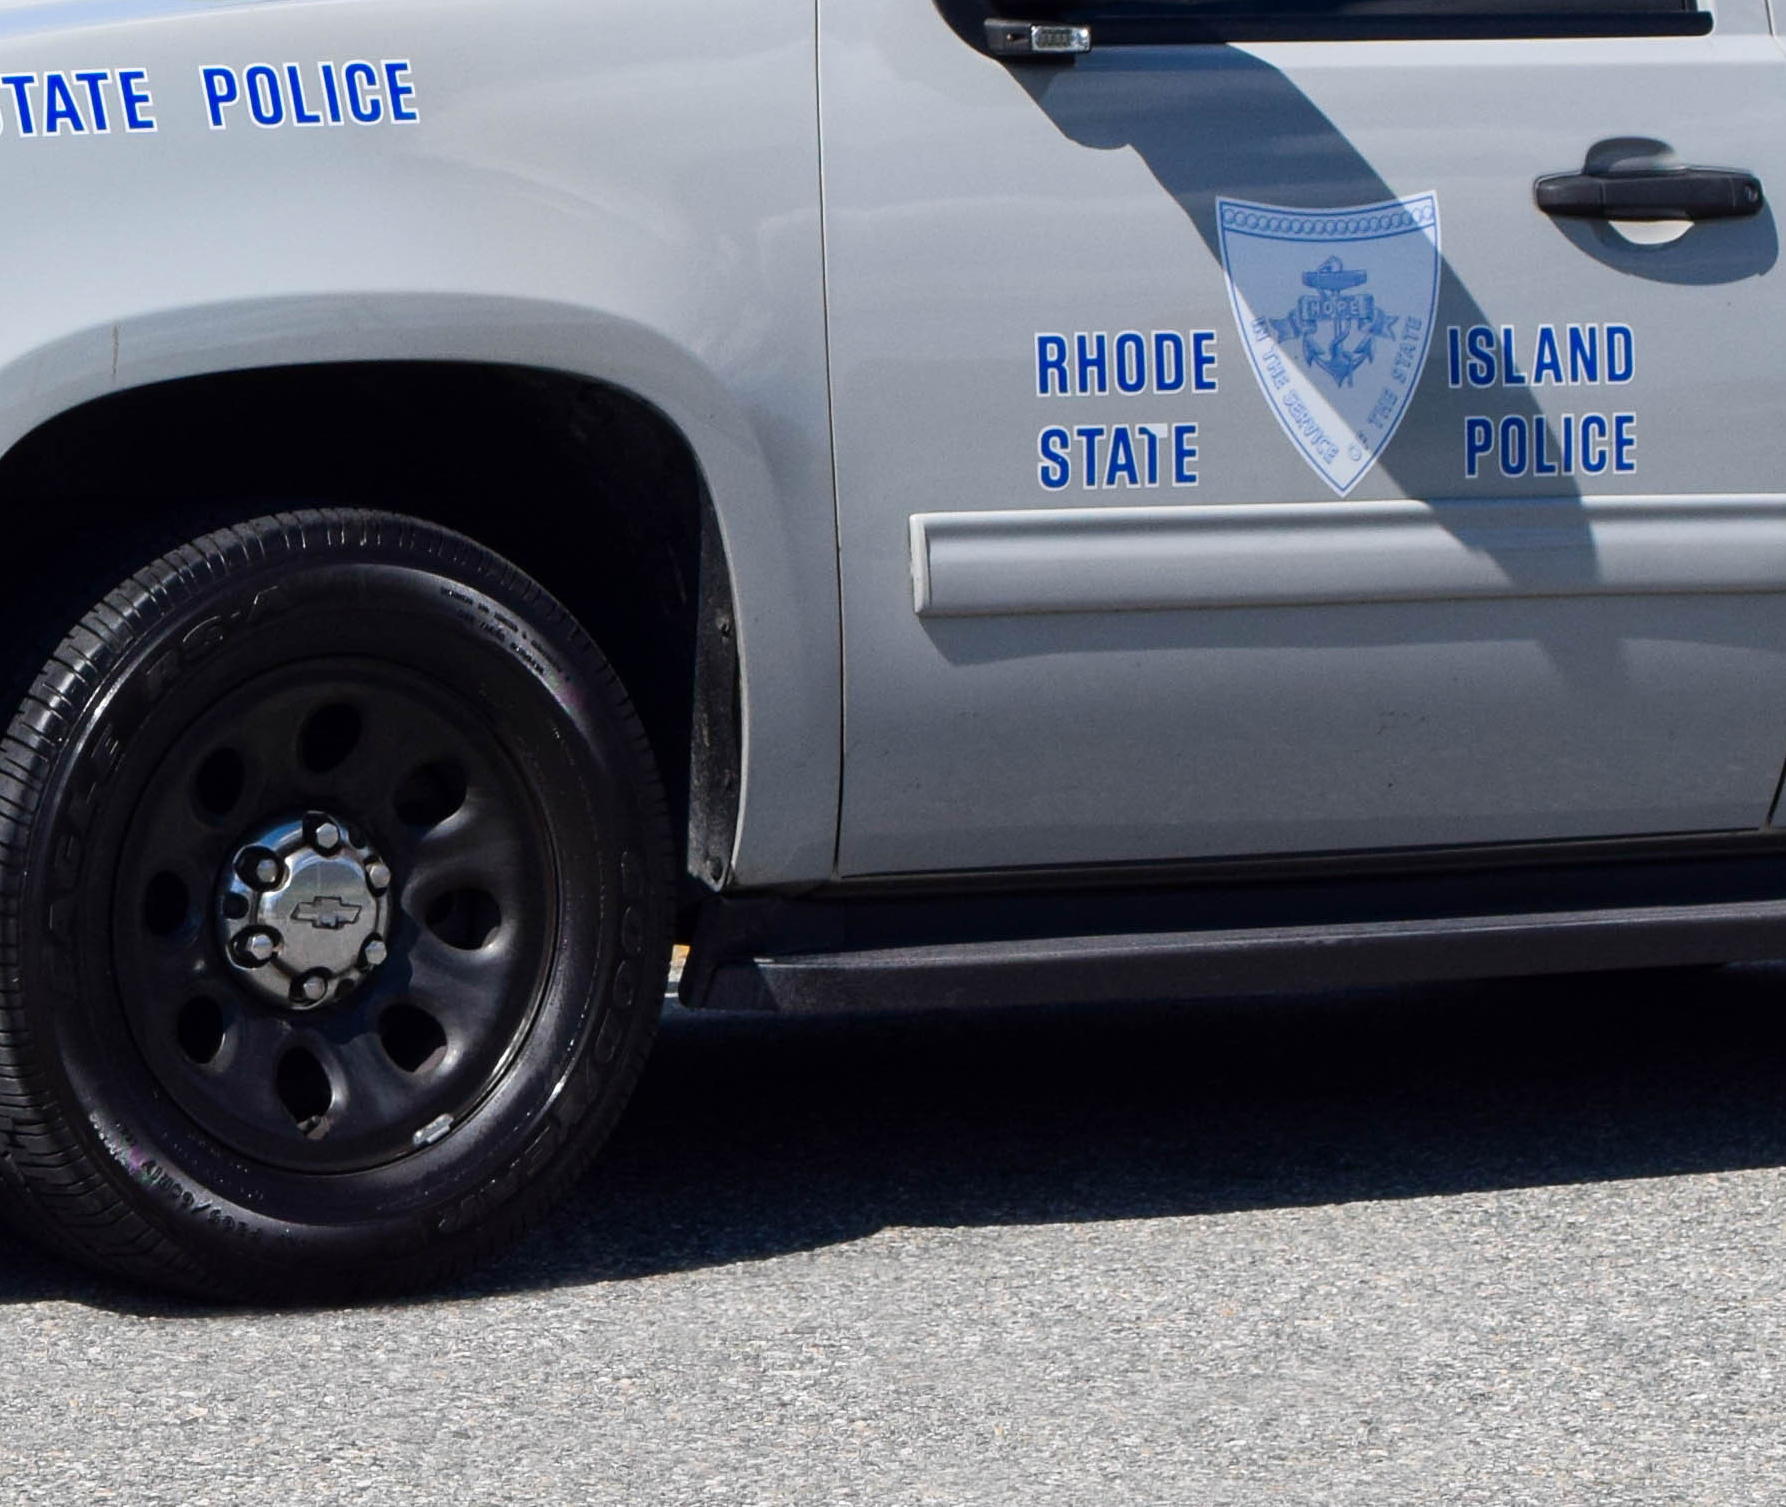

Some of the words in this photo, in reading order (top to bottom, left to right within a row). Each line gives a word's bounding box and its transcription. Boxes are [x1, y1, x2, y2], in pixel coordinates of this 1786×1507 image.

[200, 59, 420, 130] POLICE
[1309, 300, 1362, 316] HOPE
[1035, 330, 1218, 396] RHODE
[1446, 324, 1636, 389] ISLAND
[1038, 423, 1199, 490] STATE
[1464, 413, 1637, 478] POLICE
